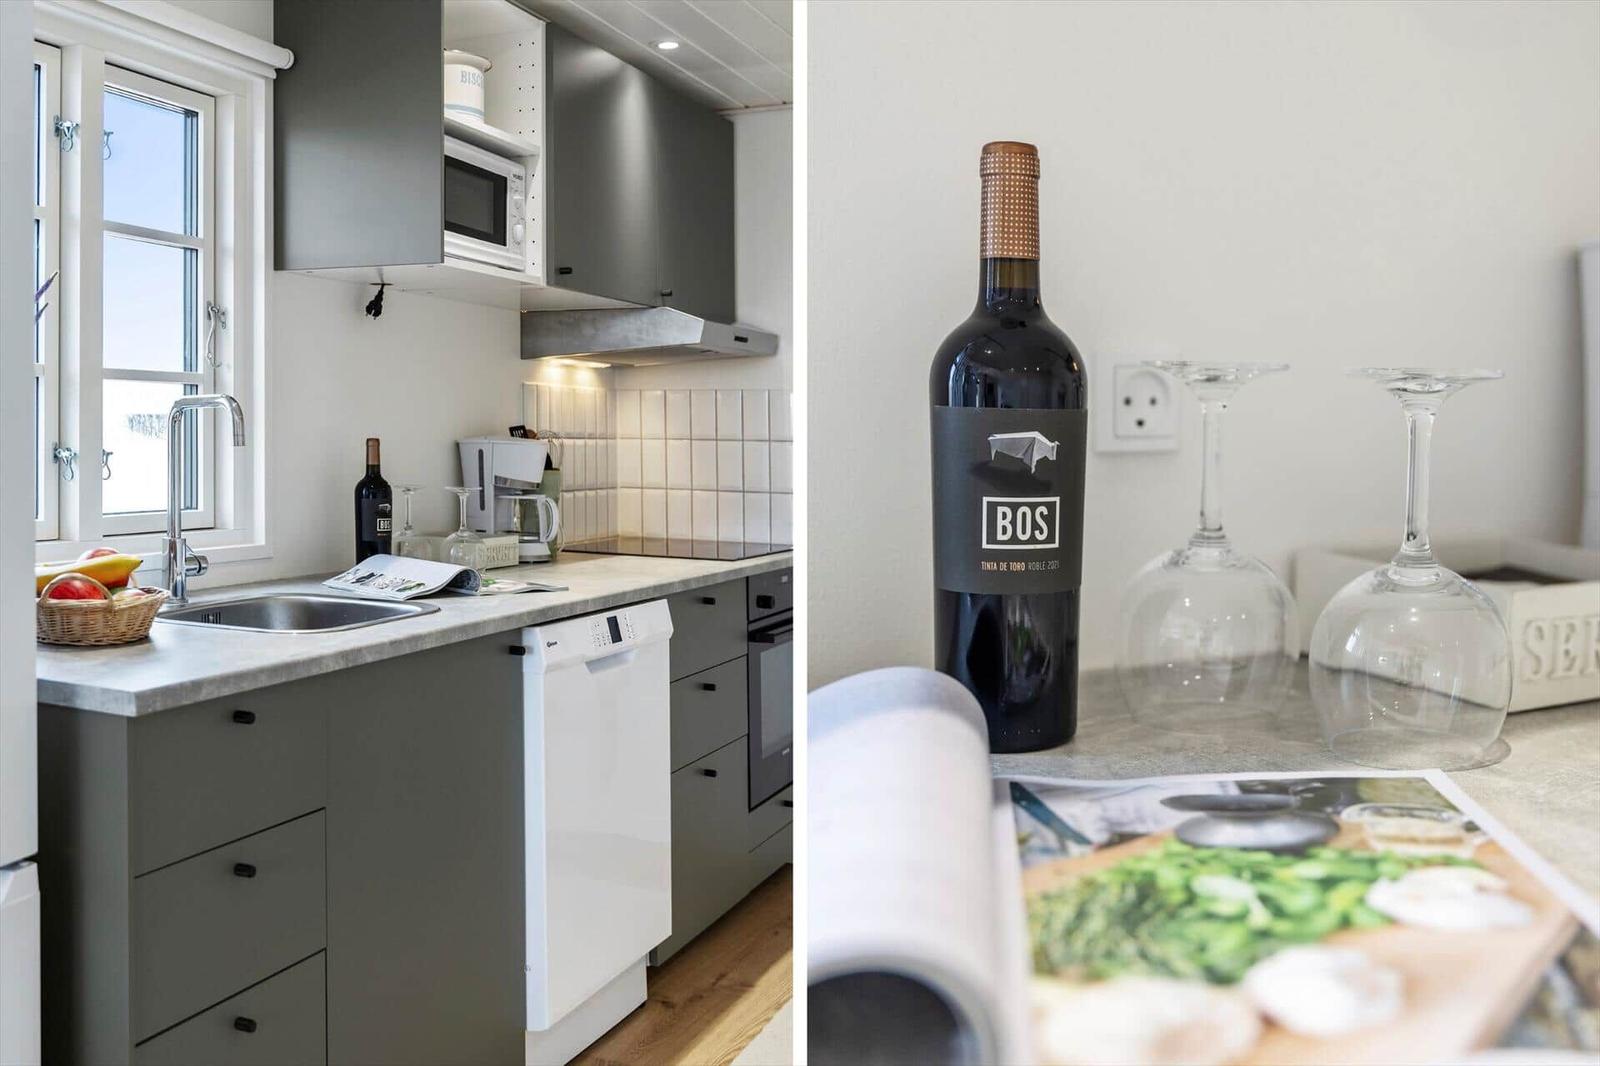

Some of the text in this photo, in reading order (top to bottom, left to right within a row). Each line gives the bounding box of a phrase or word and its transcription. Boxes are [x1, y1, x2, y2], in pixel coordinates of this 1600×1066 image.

[996, 505, 1049, 541] BOS
[980, 560, 998, 571] TINTA
[999, 561, 1008, 572] DE
[1009, 561, 1026, 572] TORO
[1027, 560, 1046, 571] ROBLE
